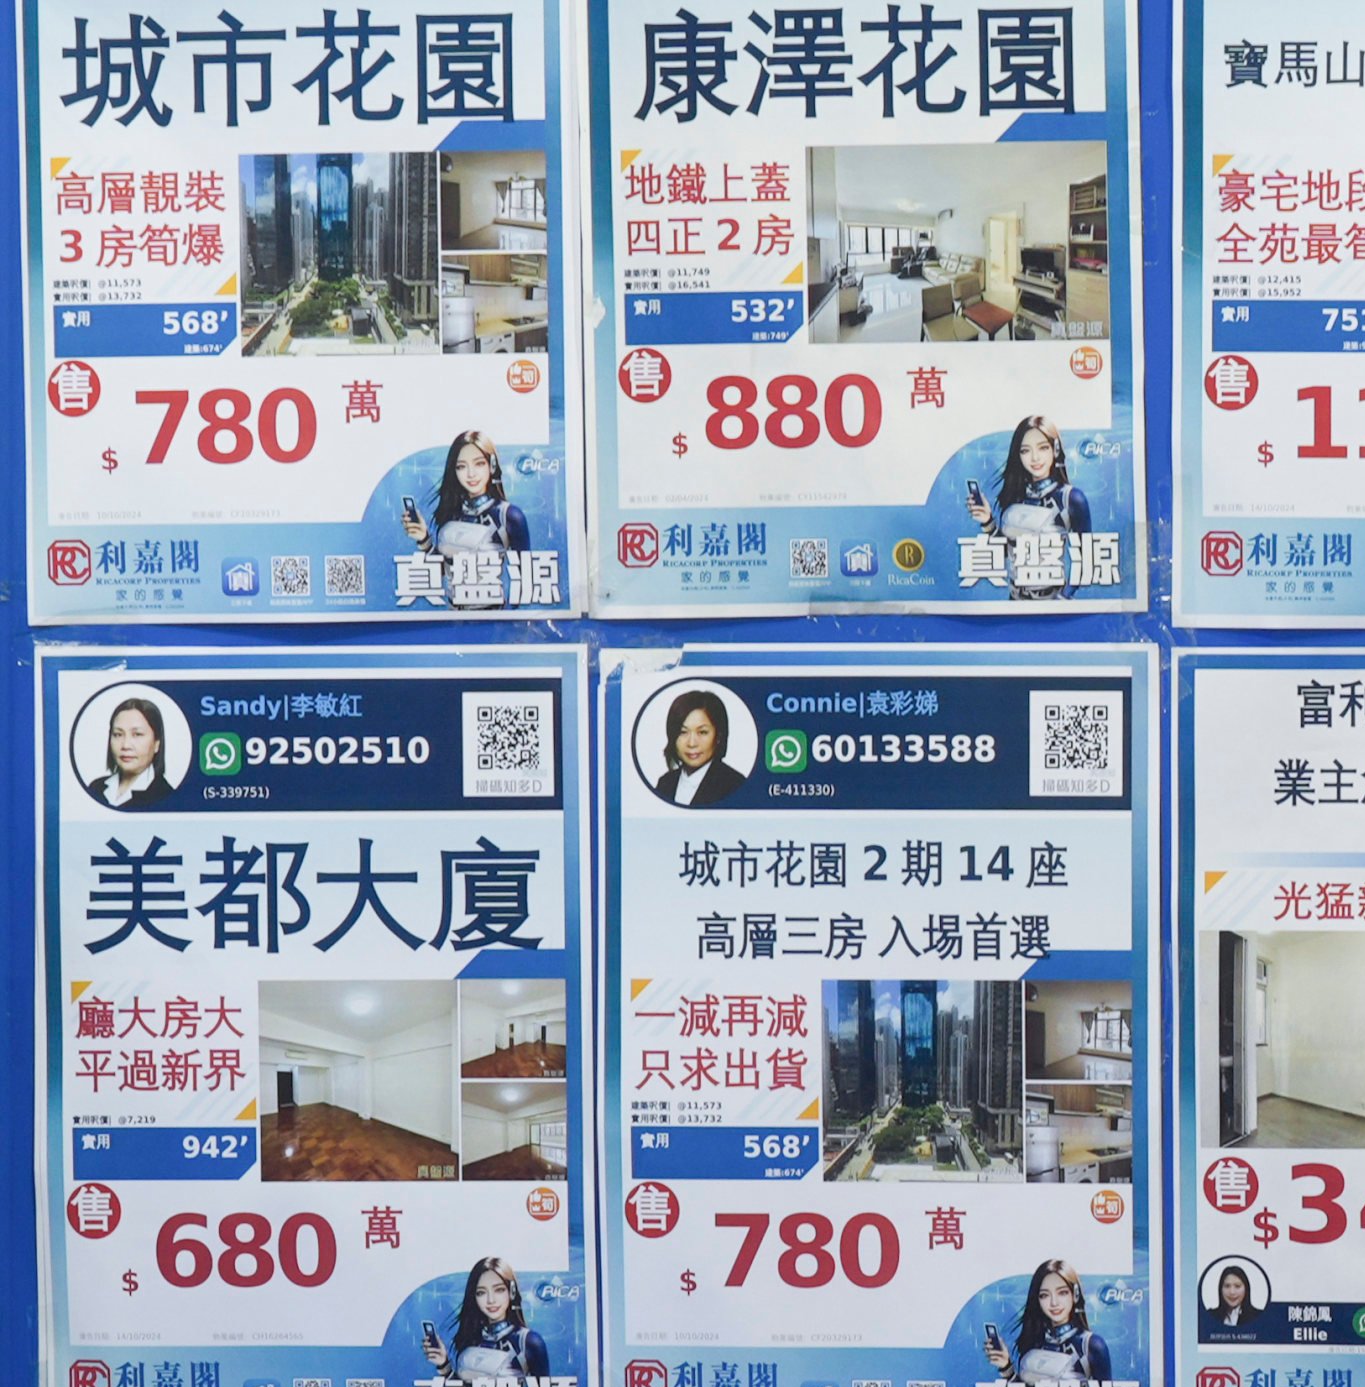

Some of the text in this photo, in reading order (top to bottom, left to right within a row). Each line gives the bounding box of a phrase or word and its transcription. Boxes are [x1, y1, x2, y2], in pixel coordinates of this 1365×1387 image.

[60, 9, 514, 128] 城市花園
[634, 4, 1077, 124] 康澤花園
[53, 170, 225, 215] 高層靚裝
[624, 162, 790, 205] 地鐵上蓋
[50, 363, 94, 411] 售
[622, 350, 665, 398] 售
[907, 366, 948, 409] 萬
[1208, 358, 1252, 406] 售
[342, 380, 383, 423] 萬
[96, 540, 199, 574] 利嘉閣
[663, 522, 766, 557] 利嘉閣
[958, 532, 1120, 590] 真盤源
[1248, 533, 1352, 567] 利嘉閣
[394, 549, 560, 607] 真盤源
[886, 572, 936, 587] RicaCoin
[246, 736, 429, 764] 92502510
[812, 735, 995, 762] 60133588
[203, 786, 269, 799] (S-339751)
[769, 784, 834, 798] (E-411330)
[679, 840, 846, 888] 城市花園
[84, 836, 544, 956] 美都大廈
[697, 911, 867, 960] 高層三房
[74, 994, 244, 1039] 廳大房大
[633, 993, 808, 1038] 一減再減
[76, 1049, 246, 1093] 平過新界
[635, 1047, 807, 1091] 只求出貨
[1207, 1159, 1251, 1209] 售
[69, 1184, 113, 1235] 售
[361, 1206, 402, 1249] 萬
[629, 1184, 672, 1232] 售
[925, 1206, 966, 1250] 萬
[1292, 1327, 1329, 1342] Ellie
